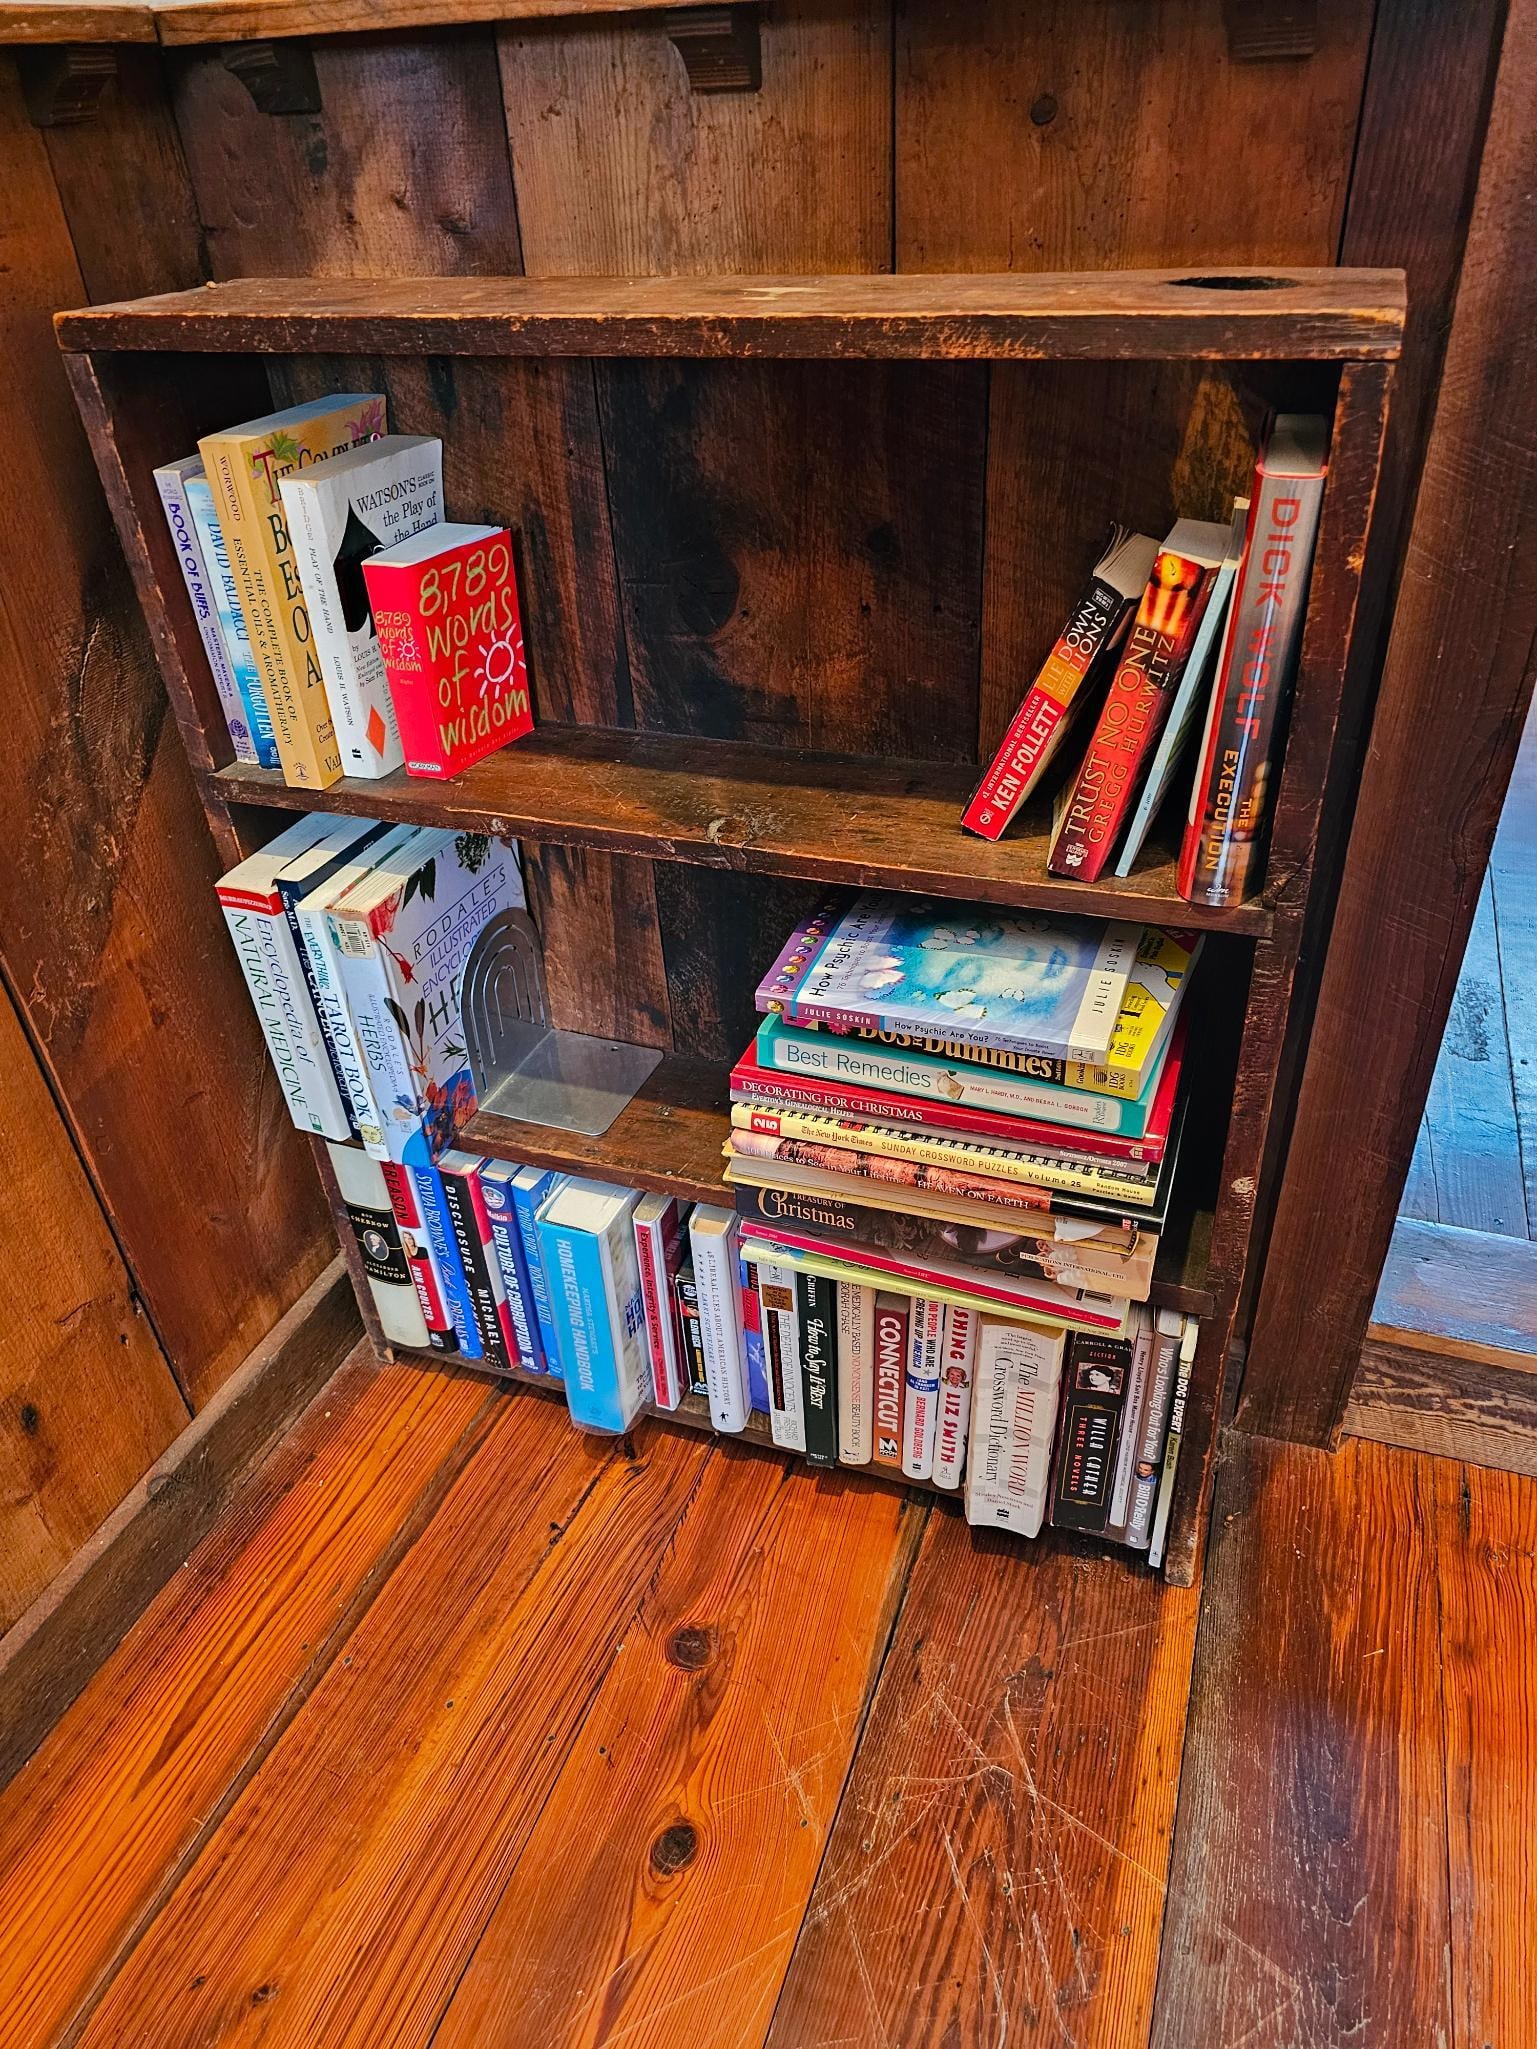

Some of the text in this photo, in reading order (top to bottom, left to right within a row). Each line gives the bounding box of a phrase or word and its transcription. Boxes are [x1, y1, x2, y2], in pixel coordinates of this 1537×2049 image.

[220, 456, 241, 521] WORWOOD
[357, 477, 418, 514] WATSON'S
[383, 491, 437, 527] the Play of
[168, 503, 193, 551] BOOK
[185, 558, 200, 578] OF
[208, 522, 250, 641] DAVID BALDACCI
[419, 544, 509, 617] 8,789
[233, 538, 257, 605] ESSENTIAL
[251, 608, 265, 638] OILS
[263, 653, 294, 746] AROMATHERAPY
[254, 570, 298, 722] THE COMPLETE BOOK OF
[378, 626, 414, 641] words
[382, 638, 395, 654] of
[426, 586, 512, 663] words
[1042, 600, 1097, 691] LIE DOWN
[1068, 613, 1108, 672] LIONS
[1234, 496, 1301, 741] DICK WOLF
[383, 655, 422, 672] wisdom
[439, 650, 470, 707] of
[439, 688, 528, 757] wisdom
[986, 694, 1042, 792] INTERNATIONAL BESTSELLER
[1064, 751, 1111, 837] TRUST
[1097, 700, 1130, 751] NO
[1117, 625, 1159, 693] ONE
[1088, 638, 1176, 844] GREGG HURWITZ
[990, 700, 1060, 813] KEN FOLLETT
[1205, 749, 1241, 873] EXECUTION
[1238, 797, 1253, 827] THE
[413, 866, 506, 960] RODALE'S
[429, 897, 498, 969] ILLUSTRATED
[303, 932, 331, 989] EVERYTHING
[809, 913, 871, 997] How Psychic Are
[1104, 938, 1126, 973] SOSKIN
[231, 912, 275, 1011] NATURAL
[265, 1017, 308, 1110] MEDICINE
[256, 918, 316, 1068] Encyclopedia of
[804, 1008, 872, 1025] JULIE SOSKIN
[1092, 979, 1113, 1014] JULIE
[323, 994, 373, 1120] TAROT BOOK
[358, 1015, 387, 1072] HERBS
[894, 1021, 989, 1043] How Psychic Are You?
[924, 1036, 1053, 1078] Dummies
[787, 1044, 931, 1088] Best Remedies
[1109, 1071, 1120, 1088] IDG
[742, 1080, 923, 1121] DECORATING FOR CHRISTMAS
[785, 1099, 830, 1114] GENEALOGICAL
[795, 1157, 806, 1165] to
[807, 1158, 825, 1168] See
[838, 1164, 861, 1176] Your
[801, 1126, 1082, 1188] The New York Times SUNDAY CROSSWORD PUZZLES Volume 25
[383, 1162, 409, 1221] TREASON
[416, 1173, 433, 1208] SYLVIA
[426, 1208, 449, 1258] BROWNE'S
[757, 1187, 855, 1230] Christmas
[793, 1192, 832, 1209] TREASURY
[967, 1189, 1030, 1210] ON EARTH
[350, 1215, 390, 1229] CHERNOW
[445, 1185, 476, 1274] DISCLOSURE
[365, 1265, 406, 1279] HAMILTON
[410, 1264, 434, 1321] ANN COULTER
[492, 1224, 533, 1353] CULTURE OF CORRUPTION
[640, 1232, 660, 1349] Experience, Integrity Service
[806, 1275, 817, 1307] GRIFFIN
[478, 1288, 500, 1346] MICHAEL
[556, 1239, 595, 1392] HOMEKEEPING HANDBOOK
[714, 1313, 723, 1336] ABOUT
[807, 1318, 827, 1347] How
[841, 1310, 850, 1335] CHASE
[914, 1297, 926, 1329] CREWING
[914, 1329, 923, 1339] UP
[925, 1314, 938, 1368] PEOPLE WHO ARE
[717, 1339, 728, 1374] AMERICAN
[803, 1354, 826, 1374] Say
[851, 1290, 861, 1447] MEDICALLY BASED BEAUTY BOOK
[912, 1338, 922, 1368] AMERICA
[1075, 1340, 1106, 1348] CARROLL
[1089, 1351, 1117, 1360] FICTION
[1138, 1350, 1147, 1368] Henry
[810, 1384, 826, 1409] BEST
[877, 1316, 902, 1432] CONNECTICUT
[1019, 1362, 1039, 1385] The
[1170, 1361, 1191, 1433] The DOG EXPERT
[915, 1396, 926, 1426] BERNARD
[940, 1391, 961, 1464] LIZ SMITH
[984, 1357, 1015, 1484] Crossword Dictionary
[1013, 1386, 1036, 1446] MILLION
[1143, 1347, 1174, 1461] Who's Looking Out for You?
[911, 1426, 925, 1459] GOLDBERG
[1069, 1417, 1088, 1492] THREE NOVELS
[1082, 1418, 1107, 1496] WILLA CATHER
[1168, 1437, 1178, 1454] Karen
[1007, 1449, 1031, 1496] WORD
[1130, 1485, 1151, 1531] Bill O'Reilly
